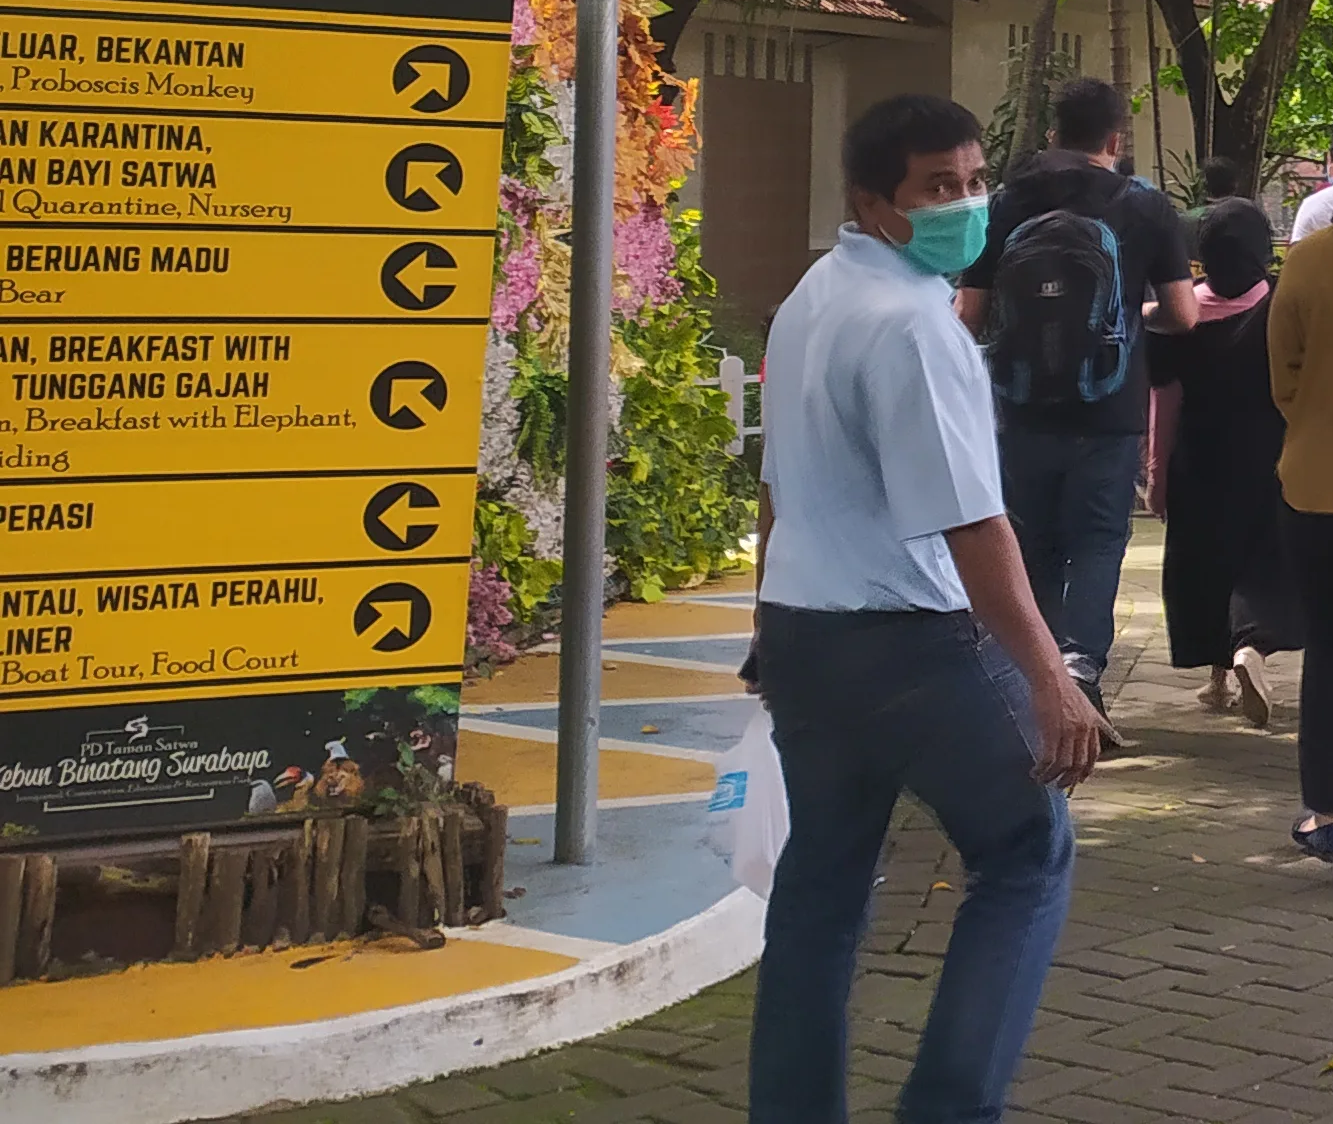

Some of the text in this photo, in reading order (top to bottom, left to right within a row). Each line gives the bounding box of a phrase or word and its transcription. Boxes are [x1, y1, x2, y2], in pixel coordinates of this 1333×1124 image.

[96, 36, 245, 68] BEKANTAN
[11, 66, 254, 105] Proboscis Monkey
[39, 120, 212, 155] KARANTINA,
[47, 158, 111, 187] BAYI
[121, 161, 217, 189] SATWA
[13, 189, 182, 219] Quarantine,
[187, 193, 292, 223] Nursery
[6, 245, 230, 273] BERUANG MADU
[0, 279, 66, 304] Bear
[49, 335, 214, 363] BREAKFAST
[225, 335, 290, 361] WITH
[12, 372, 270, 401] TUNGGANG GAJAH
[24, 406, 161, 432] Breakfast
[167, 404, 226, 429] with
[233, 403, 357, 433] Elephant,
[2, 577, 324, 618] NTAU, WISATA PERAHU,
[0, 626, 72, 656] INER
[1, 646, 300, 685] Boat Tour, Food Court
[81, 737, 199, 757] PD Taman Satwa
[57, 756, 162, 784] Binatang
[166, 745, 273, 776] Surabaya
